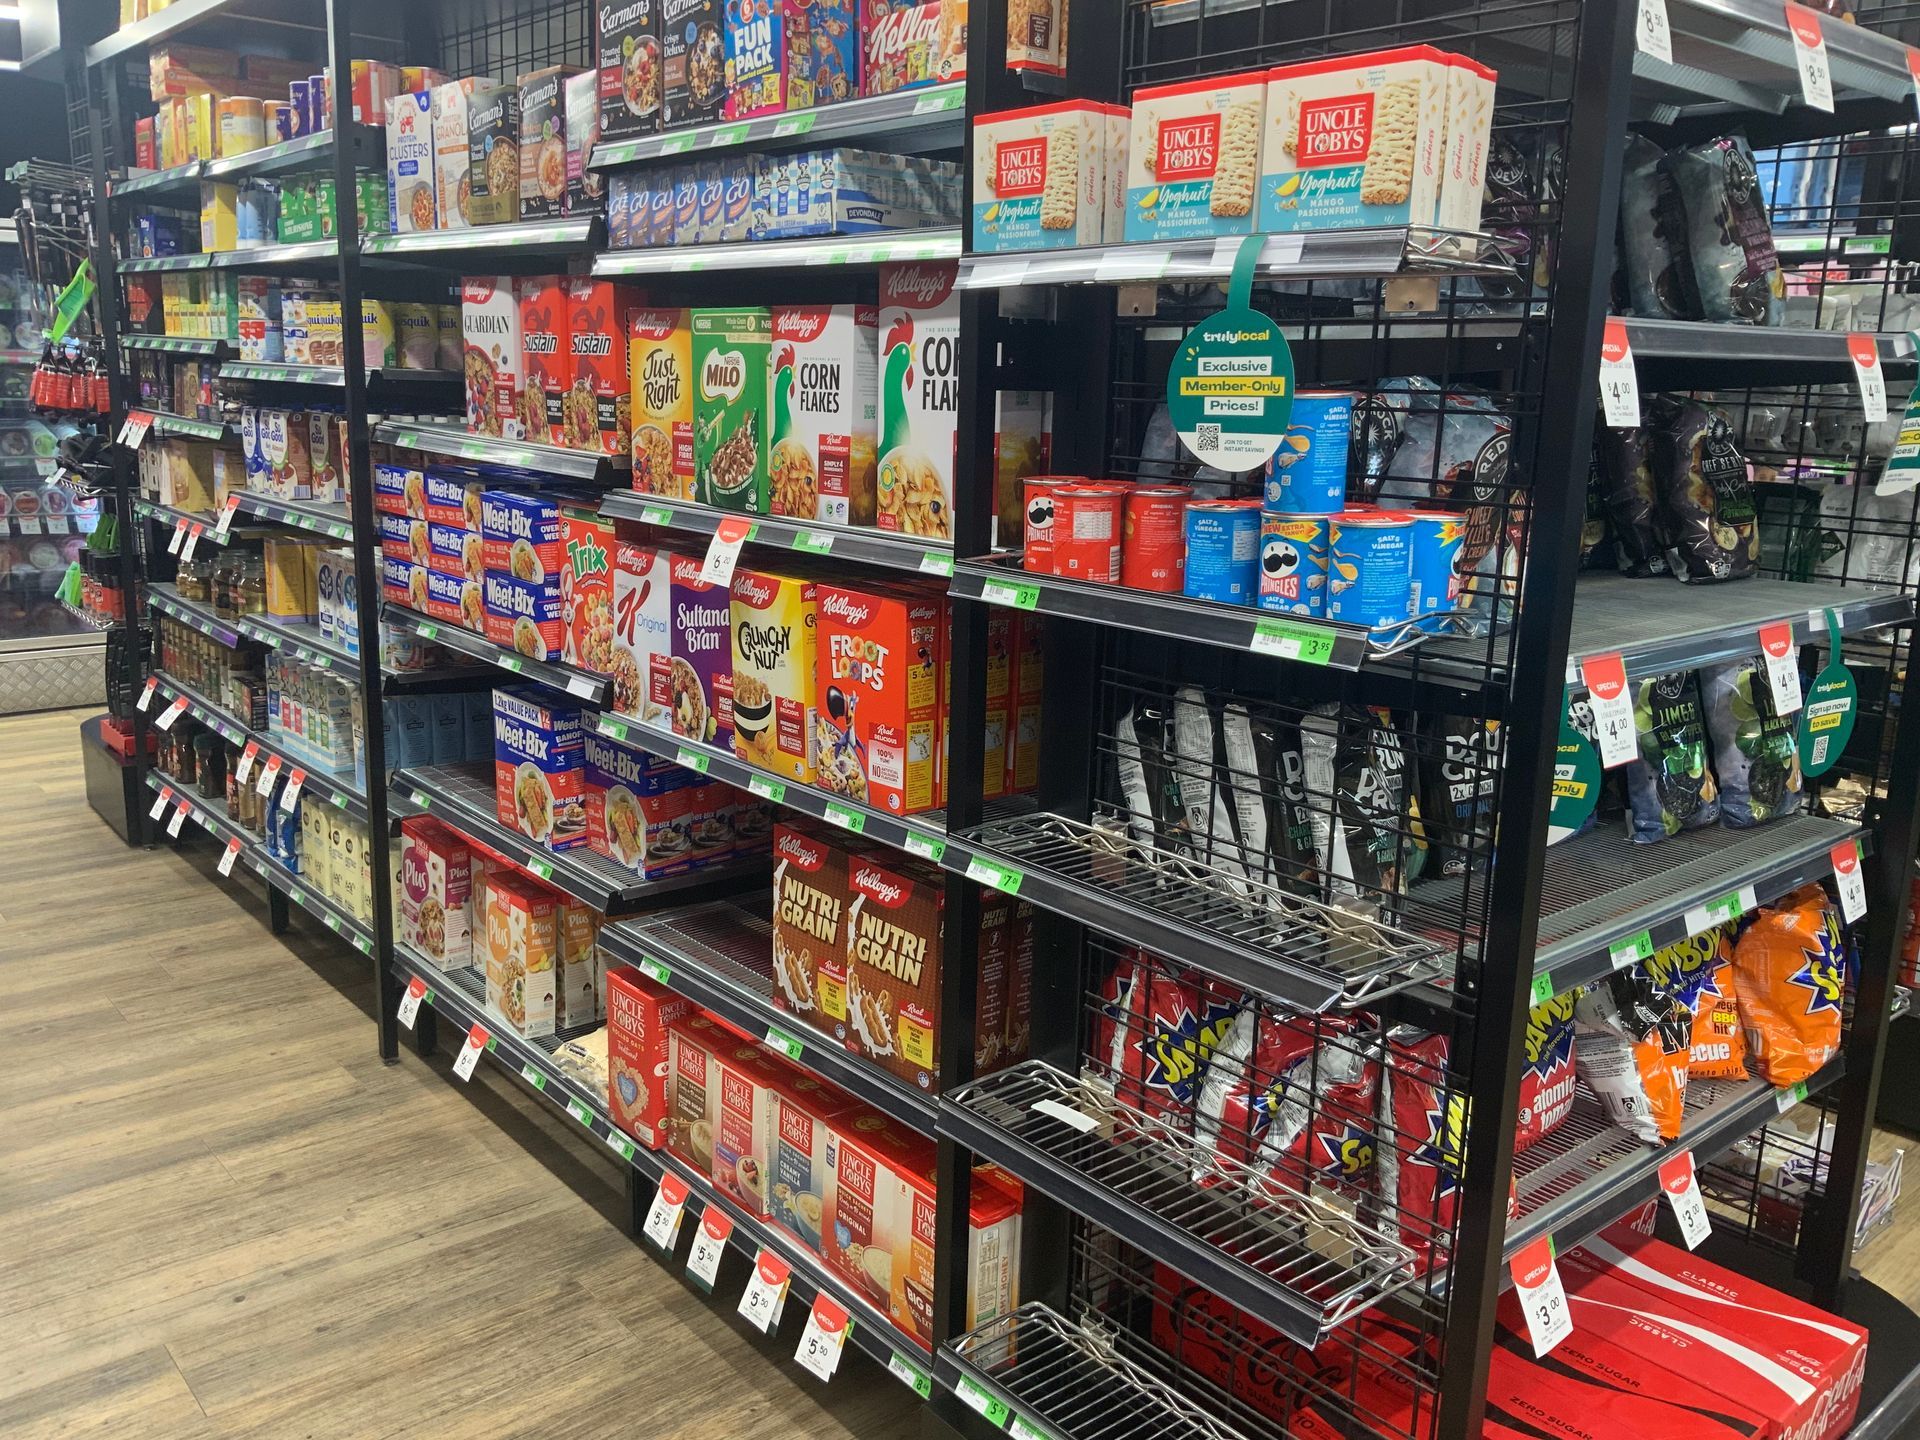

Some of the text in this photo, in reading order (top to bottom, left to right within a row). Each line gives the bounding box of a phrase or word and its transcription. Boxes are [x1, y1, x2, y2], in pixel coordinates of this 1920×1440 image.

[735, 17, 770, 56] FUN
[736, 44, 772, 76] PACK
[520, 77, 559, 111] Carman's
[469, 102, 503, 131] Carman's
[1306, 106, 1364, 131] UNCLE
[397, 133, 417, 144] PROTEIN
[1163, 126, 1213, 147] UNCLE
[1305, 130, 1365, 154] TOBYS
[389, 142, 429, 161] CLUSTERS
[1001, 154, 1041, 169] UNCLE
[1163, 146, 1214, 169] TOBYS
[1000, 168, 1041, 187] TOBYS
[1300, 169, 1360, 197] Yoghurt
[1159, 184, 1209, 210] Yoghurt
[1310, 199, 1344, 208] MANGO
[847, 207, 884, 223] DEVONDALE
[999, 200, 1040, 224] Yoghurt
[1158, 217, 1209, 228] PASSIONFRUIT
[1168, 210, 1196, 219] MANGO
[1298, 206, 1359, 217] PASSIONFRUIT
[998, 229, 1040, 239] PASSIONFRUIT
[1006, 223, 1030, 232] MANGO
[888, 267, 946, 300] Kellogg's
[464, 314, 511, 334] GUARDIAN
[635, 315, 671, 335] Kellogg's
[777, 314, 819, 338] Kellogg's
[524, 334, 557, 353] Sustain
[572, 334, 611, 355] Sustain
[1203, 329, 1269, 344] trulylocal
[644, 349, 676, 381] Just
[707, 363, 740, 387] MILO
[1203, 361, 1267, 374] Exclusive
[801, 363, 840, 390] CORN
[643, 376, 680, 410] Right
[1185, 381, 1281, 395] Member-Only
[801, 391, 839, 414] FLAKES
[1209, 400, 1259, 412] Prices!
[1329, 406, 1342, 414] SALT
[678, 444, 692, 452] HIGH
[679, 451, 693, 460] FIBRE
[376, 469, 404, 488] Weet-Bix
[428, 479, 463, 501] Weet-Bix
[483, 501, 534, 538] Weet-Bix
[1194, 525, 1223, 534] VINEGAR
[1263, 523, 1305, 534] NEW EXTRA
[432, 529, 462, 551] Weet-Bix
[1372, 541, 1405, 550] VINEGAR
[568, 533, 608, 581] Trix
[617, 547, 647, 572] Kellogg's
[429, 576, 461, 600] Weet-Bix
[487, 577, 536, 617] Weet-Bix
[734, 580, 770, 604] Kellogg's
[1261, 575, 1298, 599] PRINGLES
[677, 603, 730, 629] Sultana
[824, 595, 869, 624] Kellogg's
[1262, 602, 1290, 611] VINEGAR
[637, 613, 667, 634] Original
[686, 628, 719, 653] Bran
[738, 622, 791, 661] CRUNCHY
[830, 635, 889, 662] FROOT
[1307, 639, 1329, 656] $3.95
[1769, 641, 1786, 651] SPECIAL
[755, 653, 778, 671] NUT
[832, 659, 884, 691] LOOPS
[1596, 681, 1619, 692] SPECIAL
[508, 699, 539, 723] VALUE PACK
[1810, 706, 1822, 717] Sign
[1832, 702, 1848, 711] now
[877, 724, 894, 736] Real
[1813, 717, 1839, 728] to save!
[495, 716, 549, 761] Weet-Bix
[875, 734, 897, 745] DELICIOUS
[585, 736, 641, 784] Weet-Bix
[877, 748, 894, 759] 100%
[872, 764, 881, 777] NO
[779, 835, 818, 866] Kellogg's
[404, 859, 427, 893] Plus
[449, 865, 469, 880] Plus
[856, 868, 901, 900] Kellogg's
[784, 875, 842, 922] NUTRI
[531, 922, 552, 935] Plus
[781, 899, 837, 946] GRAIN
[489, 918, 509, 952] Plus
[532, 936, 552, 946] PROTEIN
[861, 910, 927, 962] NUTRI
[825, 960, 841, 972] Real
[857, 940, 922, 987] GRAIN
[612, 988, 645, 1021] UNCLE
[907, 1003, 924, 1016] Real
[612, 1005, 645, 1038] TOBYS
[1714, 1022, 1728, 1036] hit
[680, 1044, 704, 1068] UNCLE
[680, 1055, 704, 1080] TOBYS
[724, 1074, 750, 1099] UNCLE
[1533, 1075, 1577, 1114] atomic
[724, 1087, 750, 1114] TOBYS
[782, 1107, 810, 1133] UNCLE
[722, 1127, 740, 1144] BERRY
[782, 1119, 810, 1148] TOBYS
[828, 1132, 835, 1143] 10
[722, 1136, 744, 1155] VARIETY
[780, 1160, 801, 1179] CREAMY
[841, 1150, 872, 1180] UNCLE
[780, 1169, 801, 1188] VANILLA
[841, 1164, 872, 1196] TOBYS
[1670, 1174, 1689, 1191] SPECIAL
[664, 1187, 679, 1202] SPECIAL
[654, 1211, 670, 1227] $5.50
[838, 1210, 867, 1236] ORIGINAL
[1682, 1203, 1700, 1228] $3.00
[706, 1221, 722, 1237] SPECIAL
[697, 1246, 714, 1263] $5.50
[762, 1265, 778, 1281] SPECIAL
[1001, 1255, 1009, 1284] HONEY
[1524, 1263, 1548, 1285] SPECIAL
[1682, 1270, 1739, 1297] CLASSIC
[750, 1291, 769, 1309] $5.50
[906, 1286, 923, 1311] BIG
[817, 1310, 835, 1329] SPECIAL
[1536, 1296, 1560, 1327] $3.00
[1628, 1318, 1690, 1348] CLASSIC
[808, 1337, 828, 1357] $5.50
[1560, 1345, 1641, 1389] ZERO SUGAR
[1509, 1396, 1593, 1440] ZERO SUGAR
